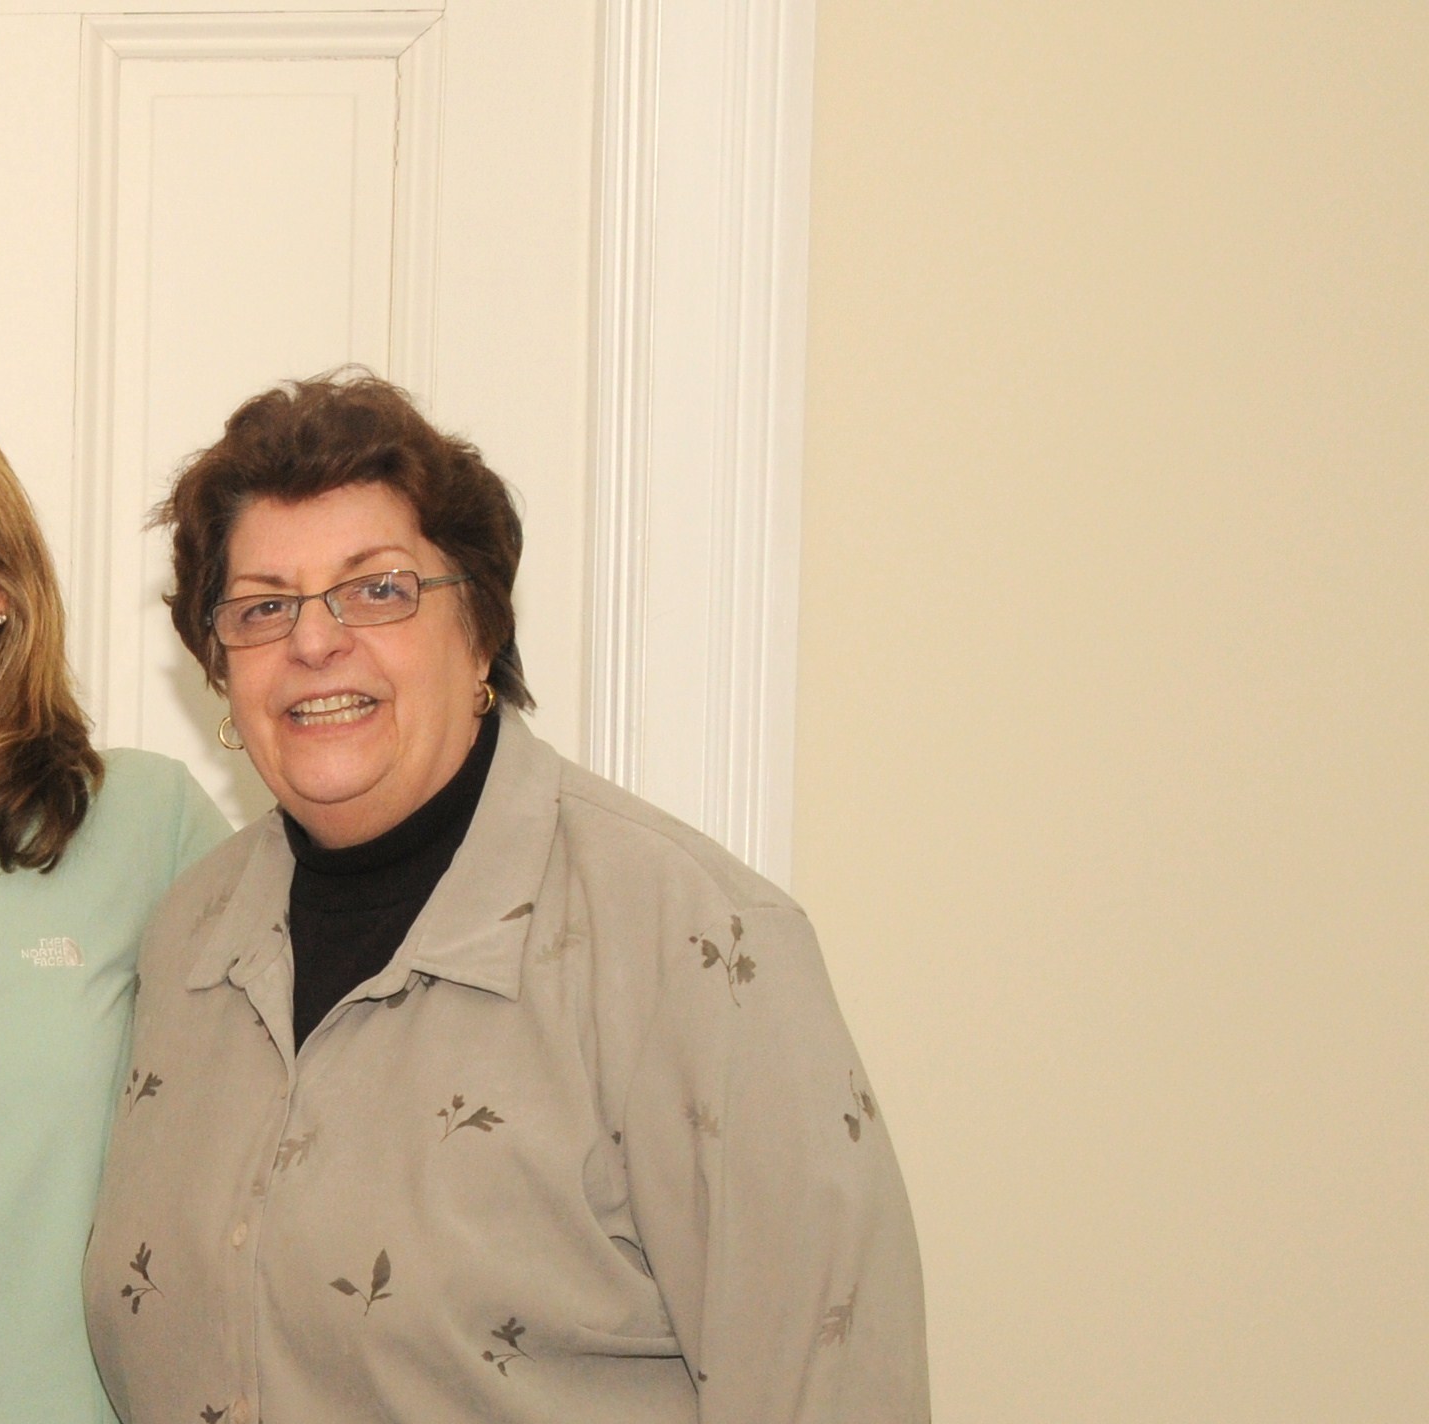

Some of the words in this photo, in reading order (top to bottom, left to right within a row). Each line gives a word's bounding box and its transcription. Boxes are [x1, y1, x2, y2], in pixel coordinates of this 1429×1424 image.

[39, 937, 63, 948] THE
[21, 948, 63, 959] NORTH
[34, 957, 64, 967] FACE
